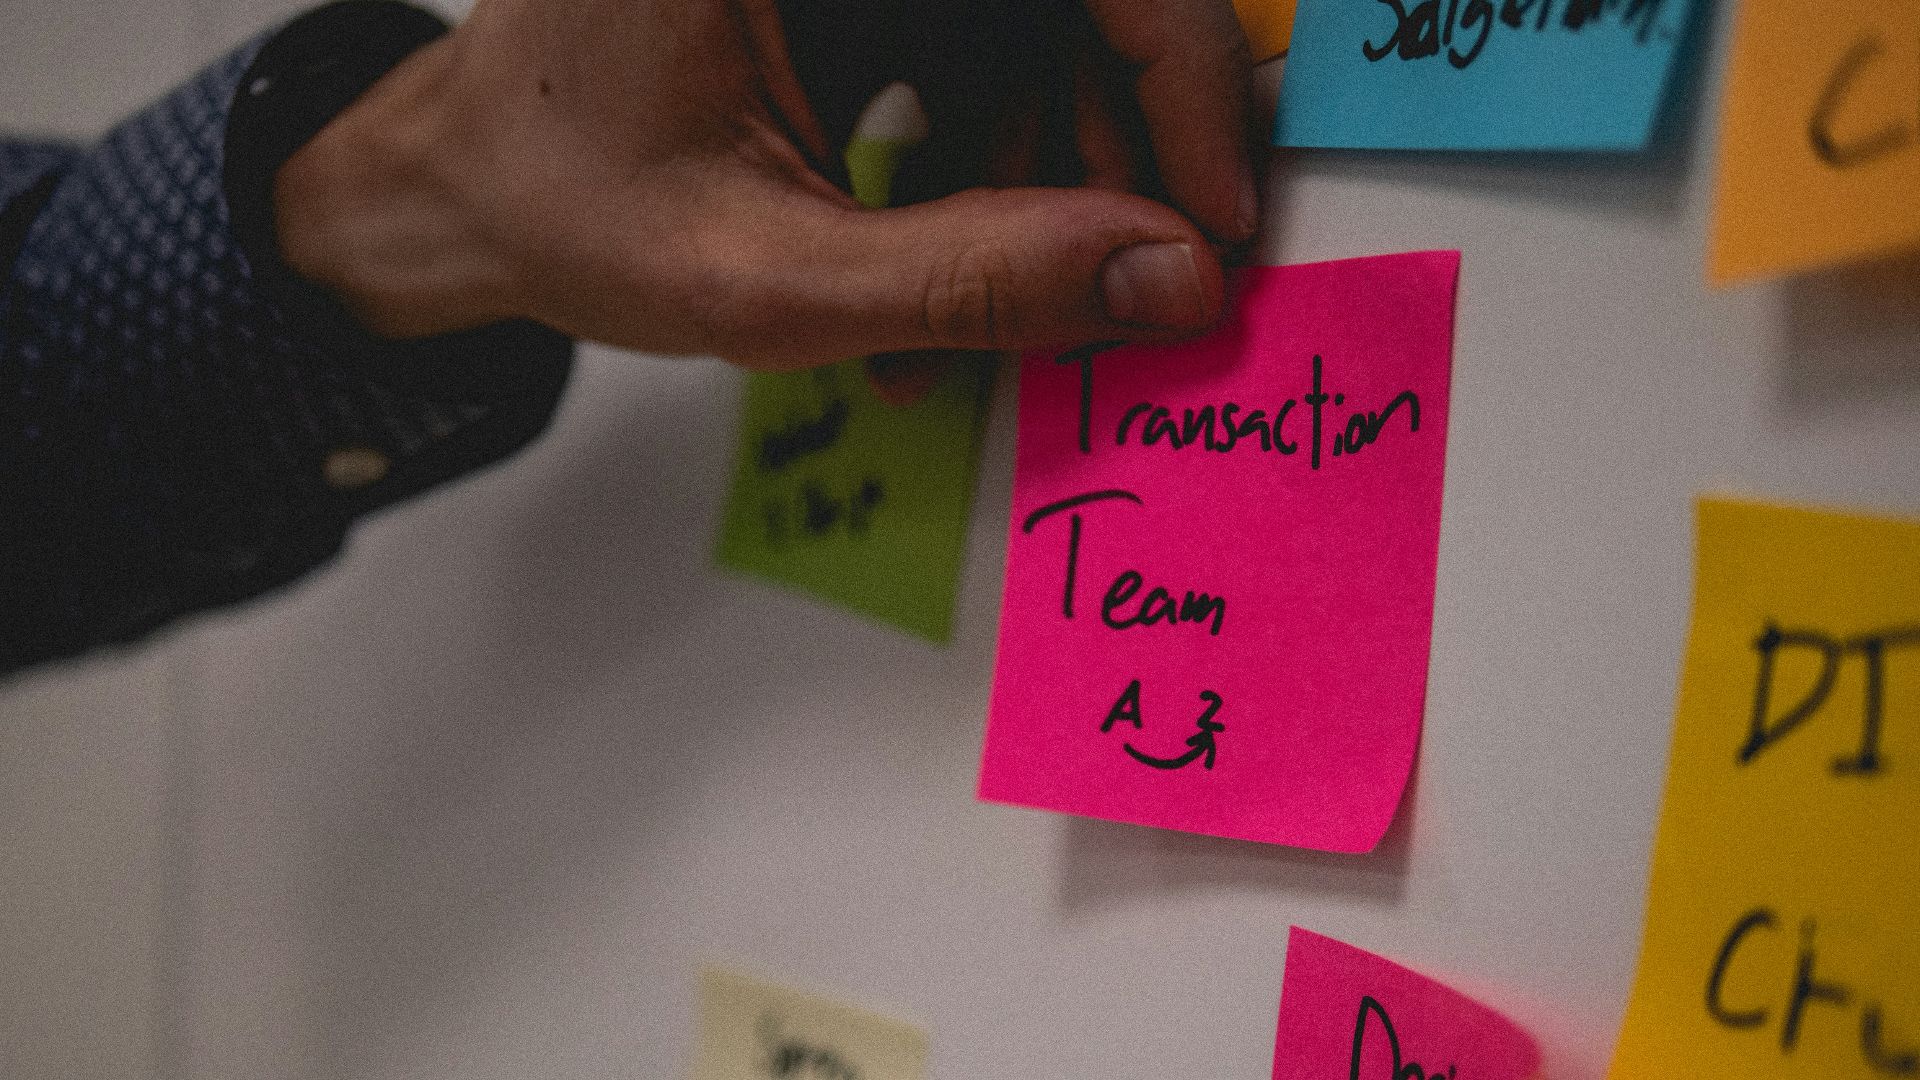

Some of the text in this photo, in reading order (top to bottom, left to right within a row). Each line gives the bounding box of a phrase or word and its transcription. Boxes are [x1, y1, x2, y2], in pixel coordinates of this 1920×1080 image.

[1055, 338, 1421, 470] Transaction
[1023, 489, 1226, 636] Team
[1101, 680, 1142, 733] A
